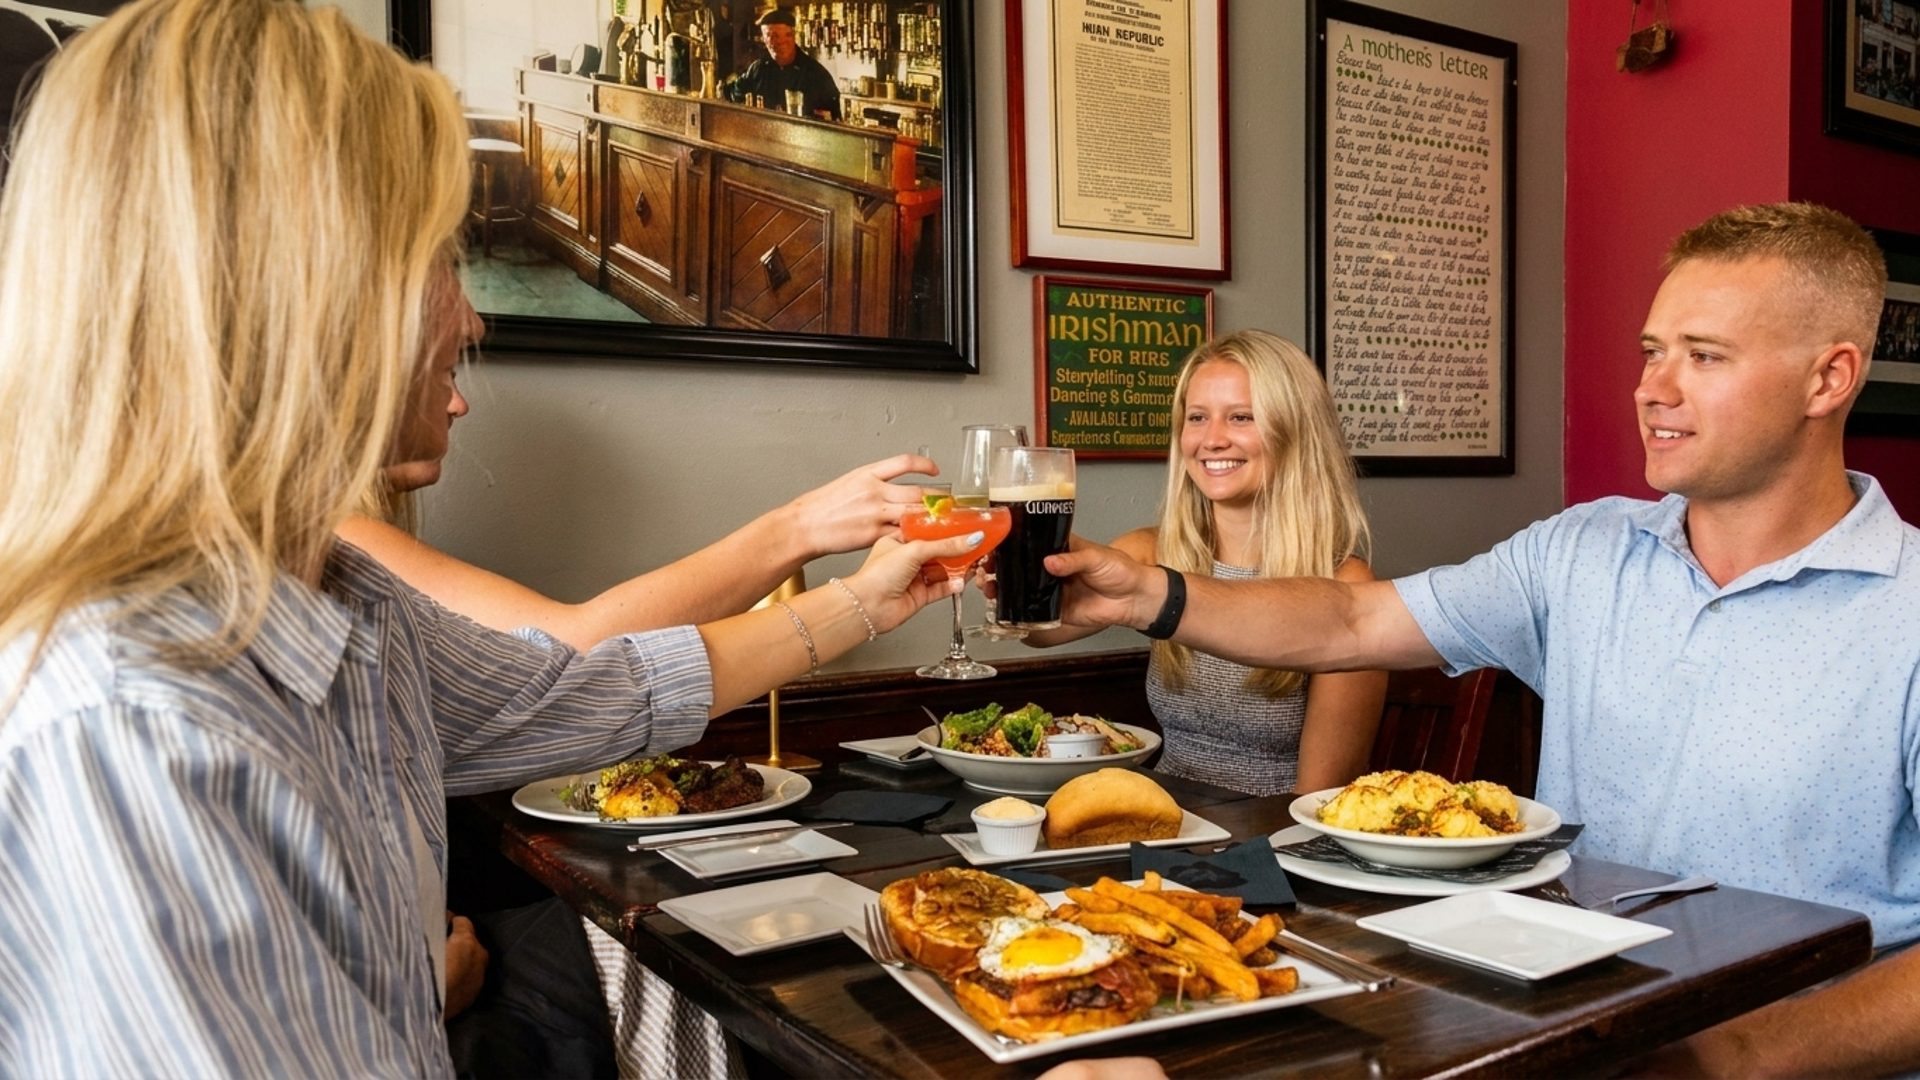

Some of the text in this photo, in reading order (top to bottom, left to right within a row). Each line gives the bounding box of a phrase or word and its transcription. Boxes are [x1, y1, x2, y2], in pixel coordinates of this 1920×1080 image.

[1343, 34, 1354, 52] A
[1066, 291, 1186, 314] AUTHENTIC
[1088, 348, 1123, 364] FOR
